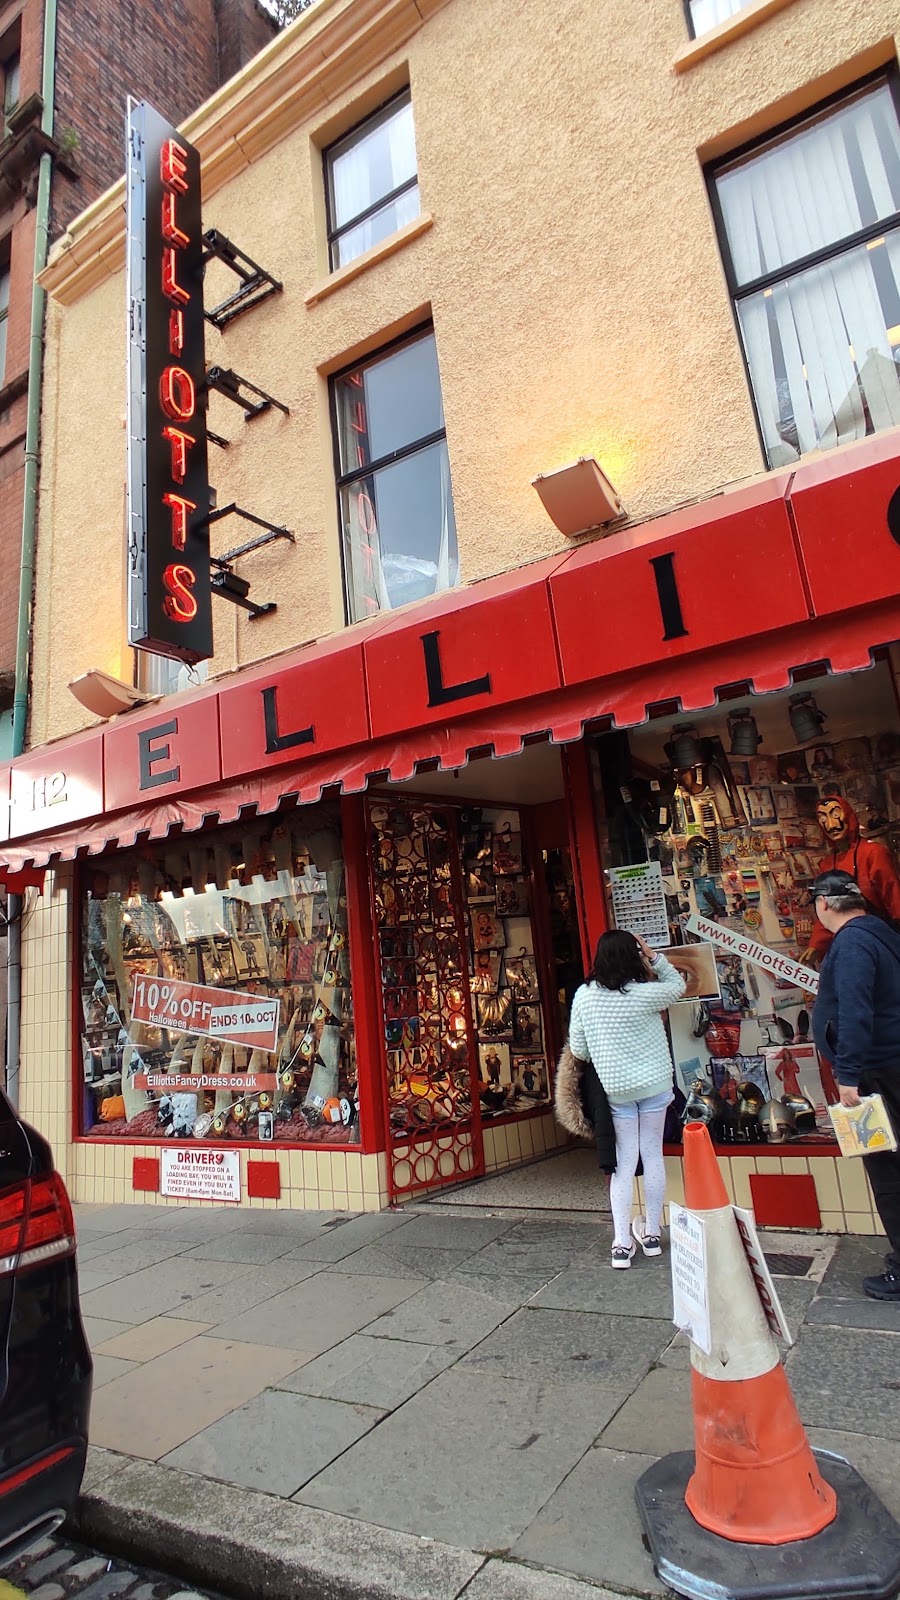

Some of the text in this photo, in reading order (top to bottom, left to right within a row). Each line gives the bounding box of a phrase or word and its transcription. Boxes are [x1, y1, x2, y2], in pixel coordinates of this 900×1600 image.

[160, 138, 198, 623] ELLIOTTS
[138, 982, 212, 1020] 10% OFF
[148, 1011, 187, 1029] Halloween
[211, 1013, 238, 1028] ENDS
[256, 1010, 275, 1023] OCT
[147, 1074, 257, 1089] ElliottsFancyDress.co.uk
[177, 1152, 224, 1165] DRIVERS
[192, 1165, 215, 1173] STOPPED
[167, 1178, 182, 1186] FINED
